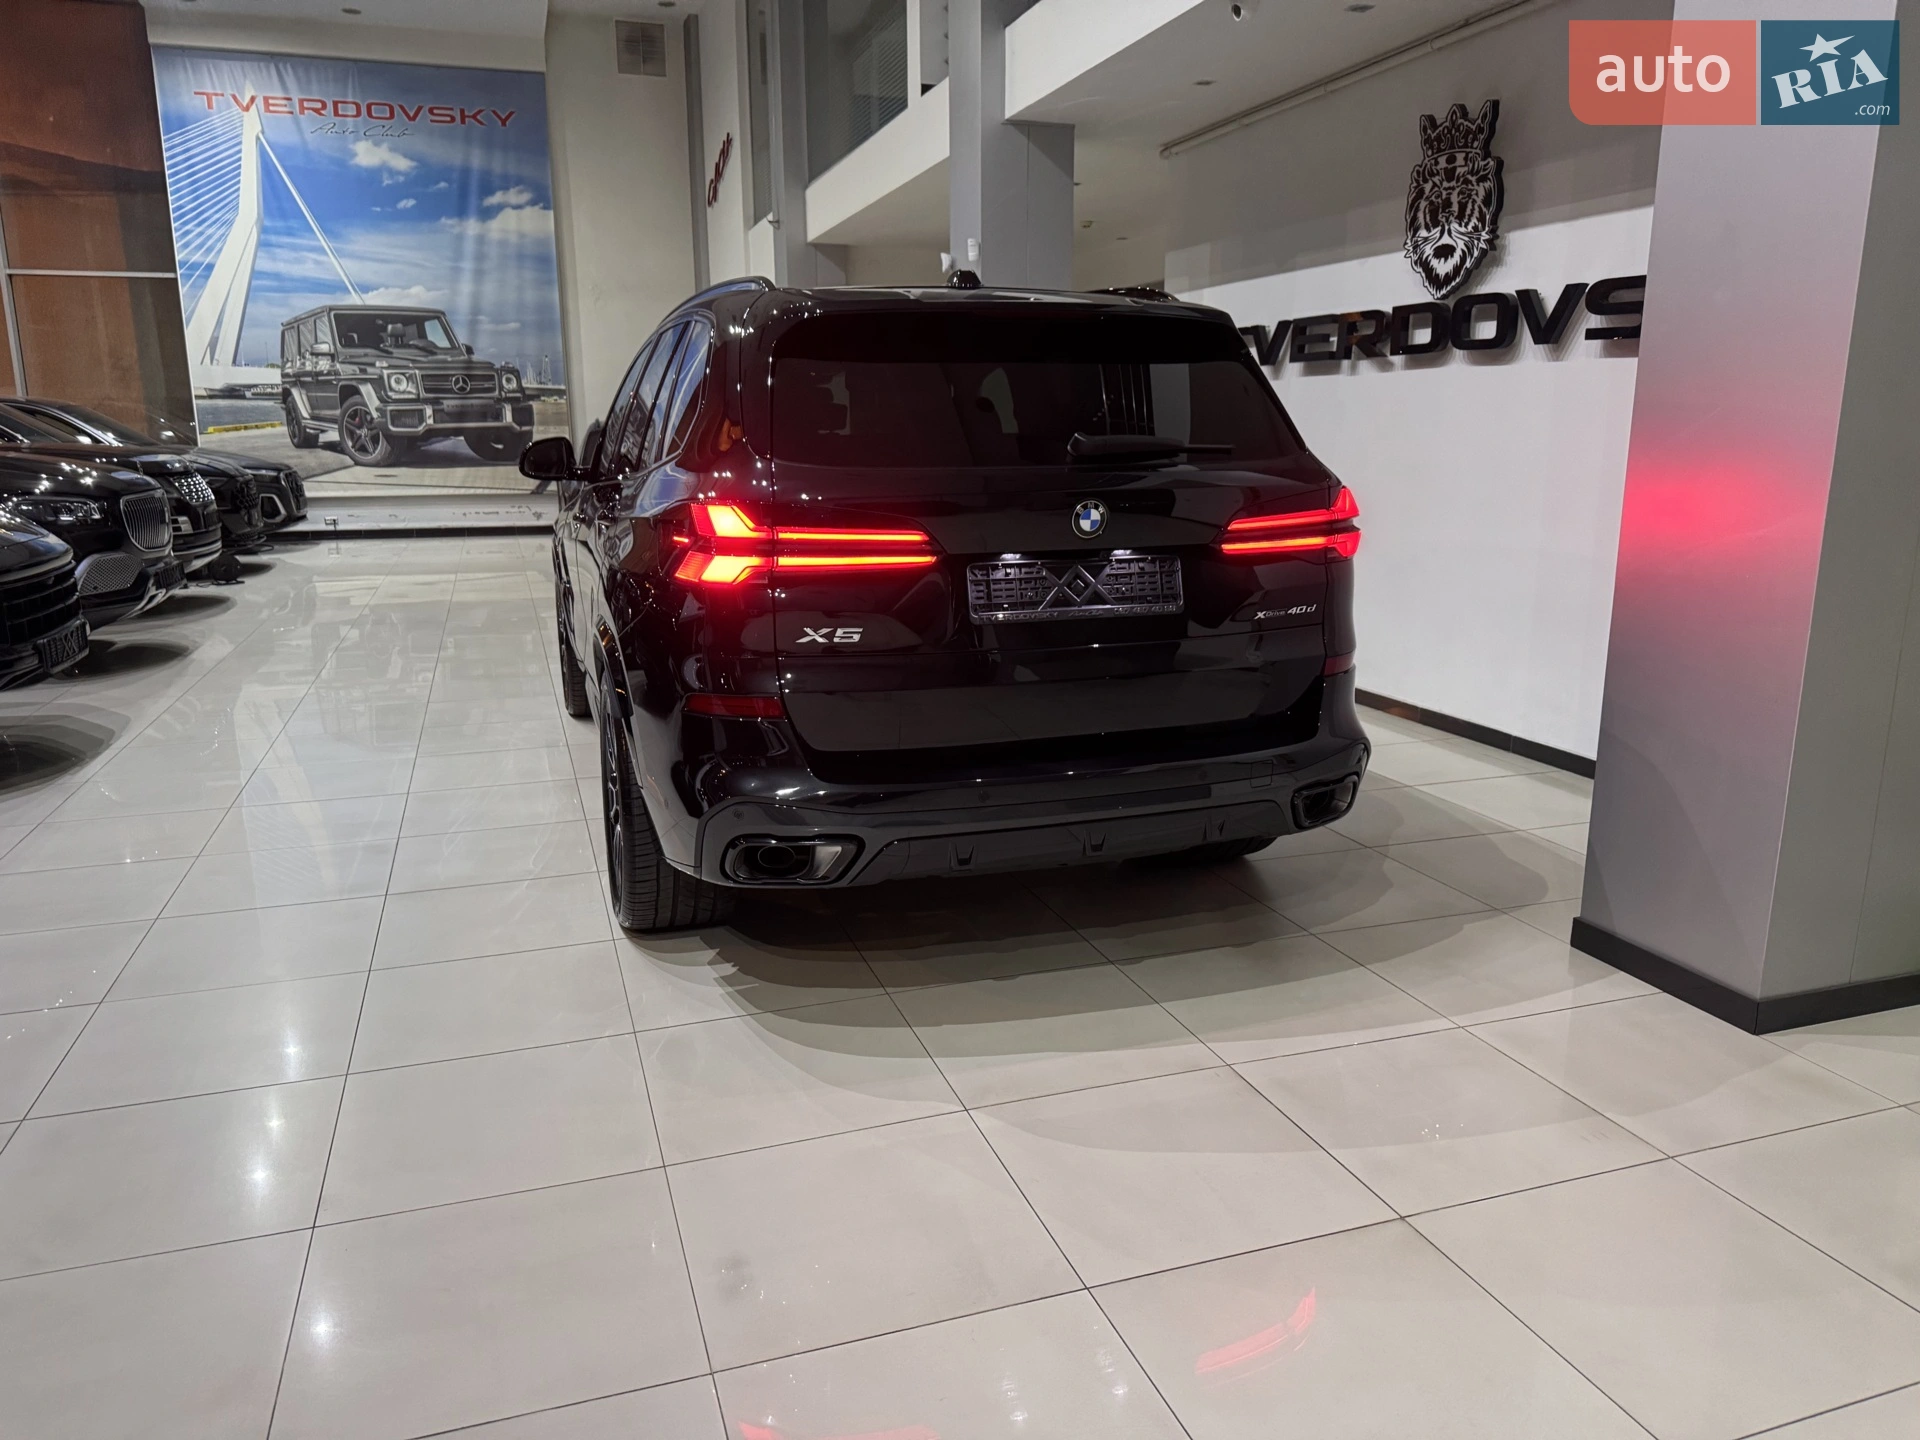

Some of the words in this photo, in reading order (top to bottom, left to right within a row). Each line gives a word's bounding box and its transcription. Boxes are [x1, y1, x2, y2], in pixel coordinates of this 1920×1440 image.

[193, 91, 516, 127] TVERDOVSKY
[310, 121, 359, 135] Auto
[363, 124, 415, 138] Club
[980, 611, 1059, 622] TVERDOVSKY
[795, 627, 864, 643] X5
